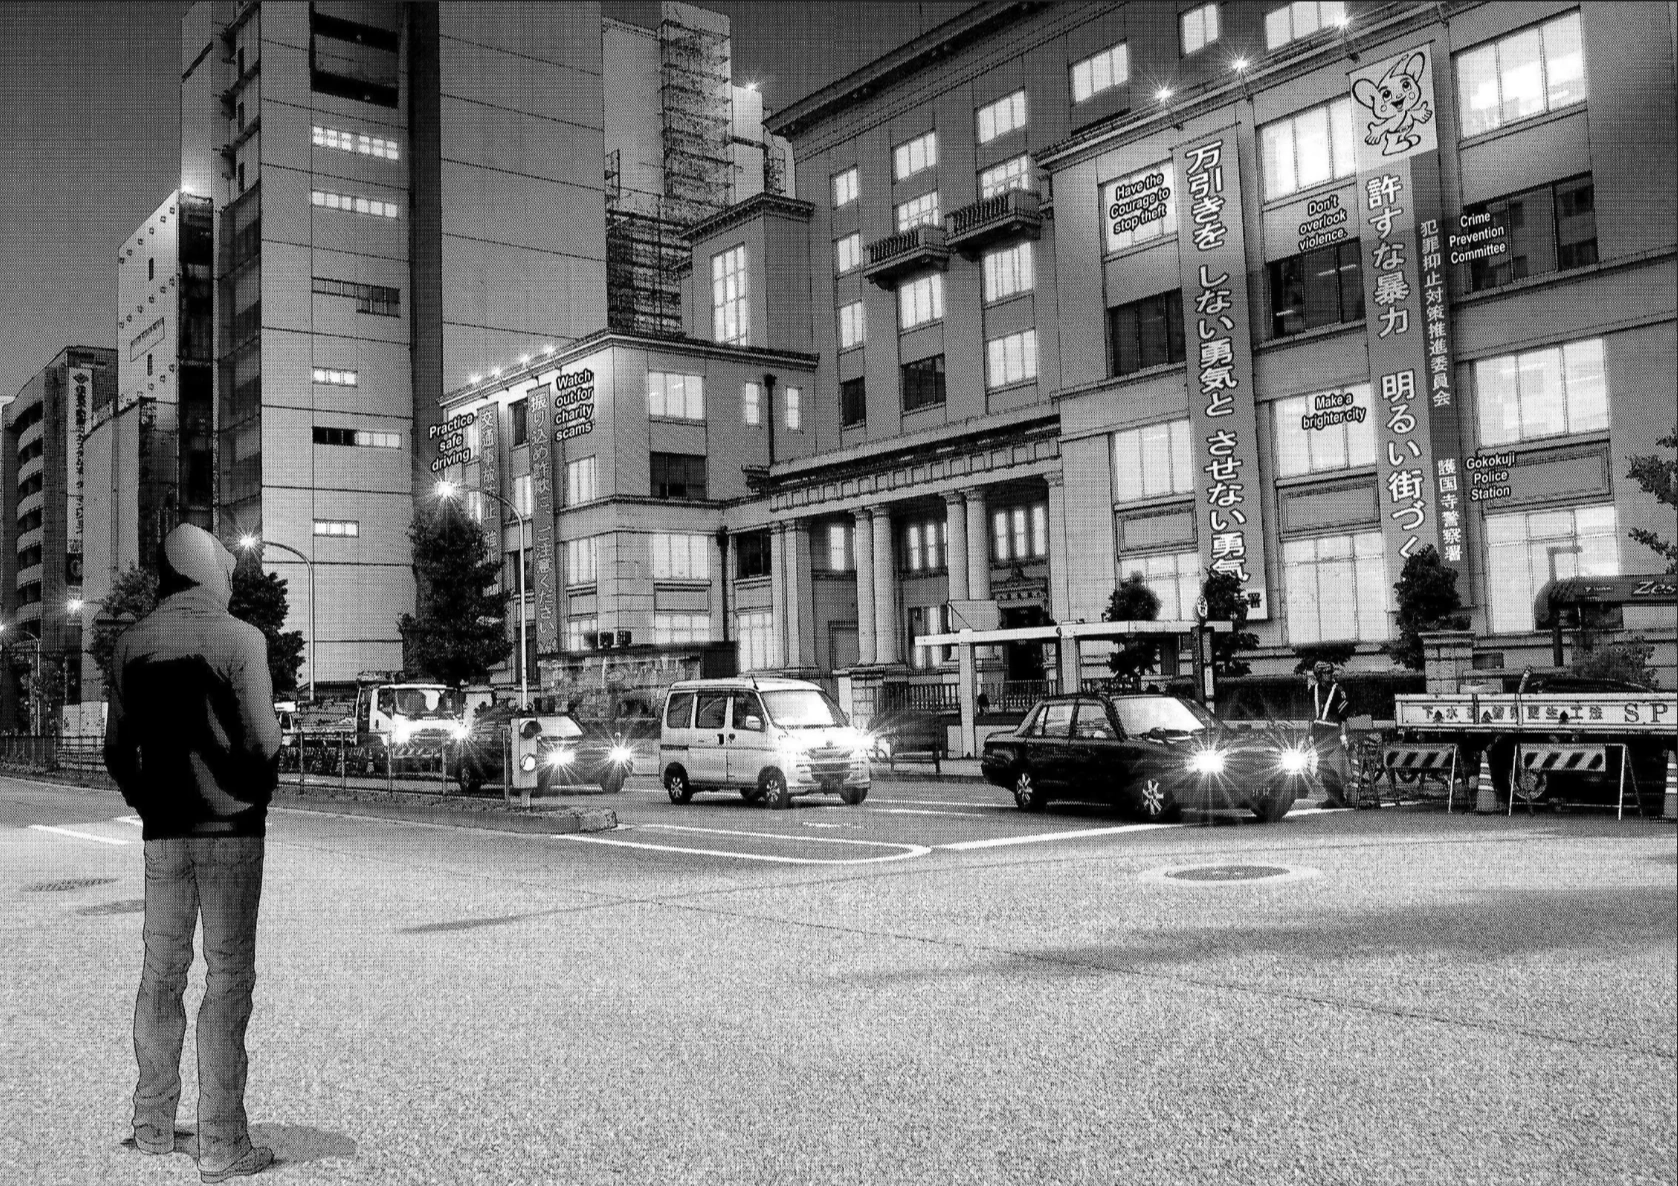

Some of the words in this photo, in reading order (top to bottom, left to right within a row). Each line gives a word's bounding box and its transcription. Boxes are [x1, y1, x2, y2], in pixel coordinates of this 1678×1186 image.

[1185, 139, 1227, 250] 万引きを
[1366, 174, 1410, 339] 許すな暴力
[1196, 265, 1239, 417] しない勇気と
[1421, 219, 1450, 407] 犯罪抑止対策推進委員会
